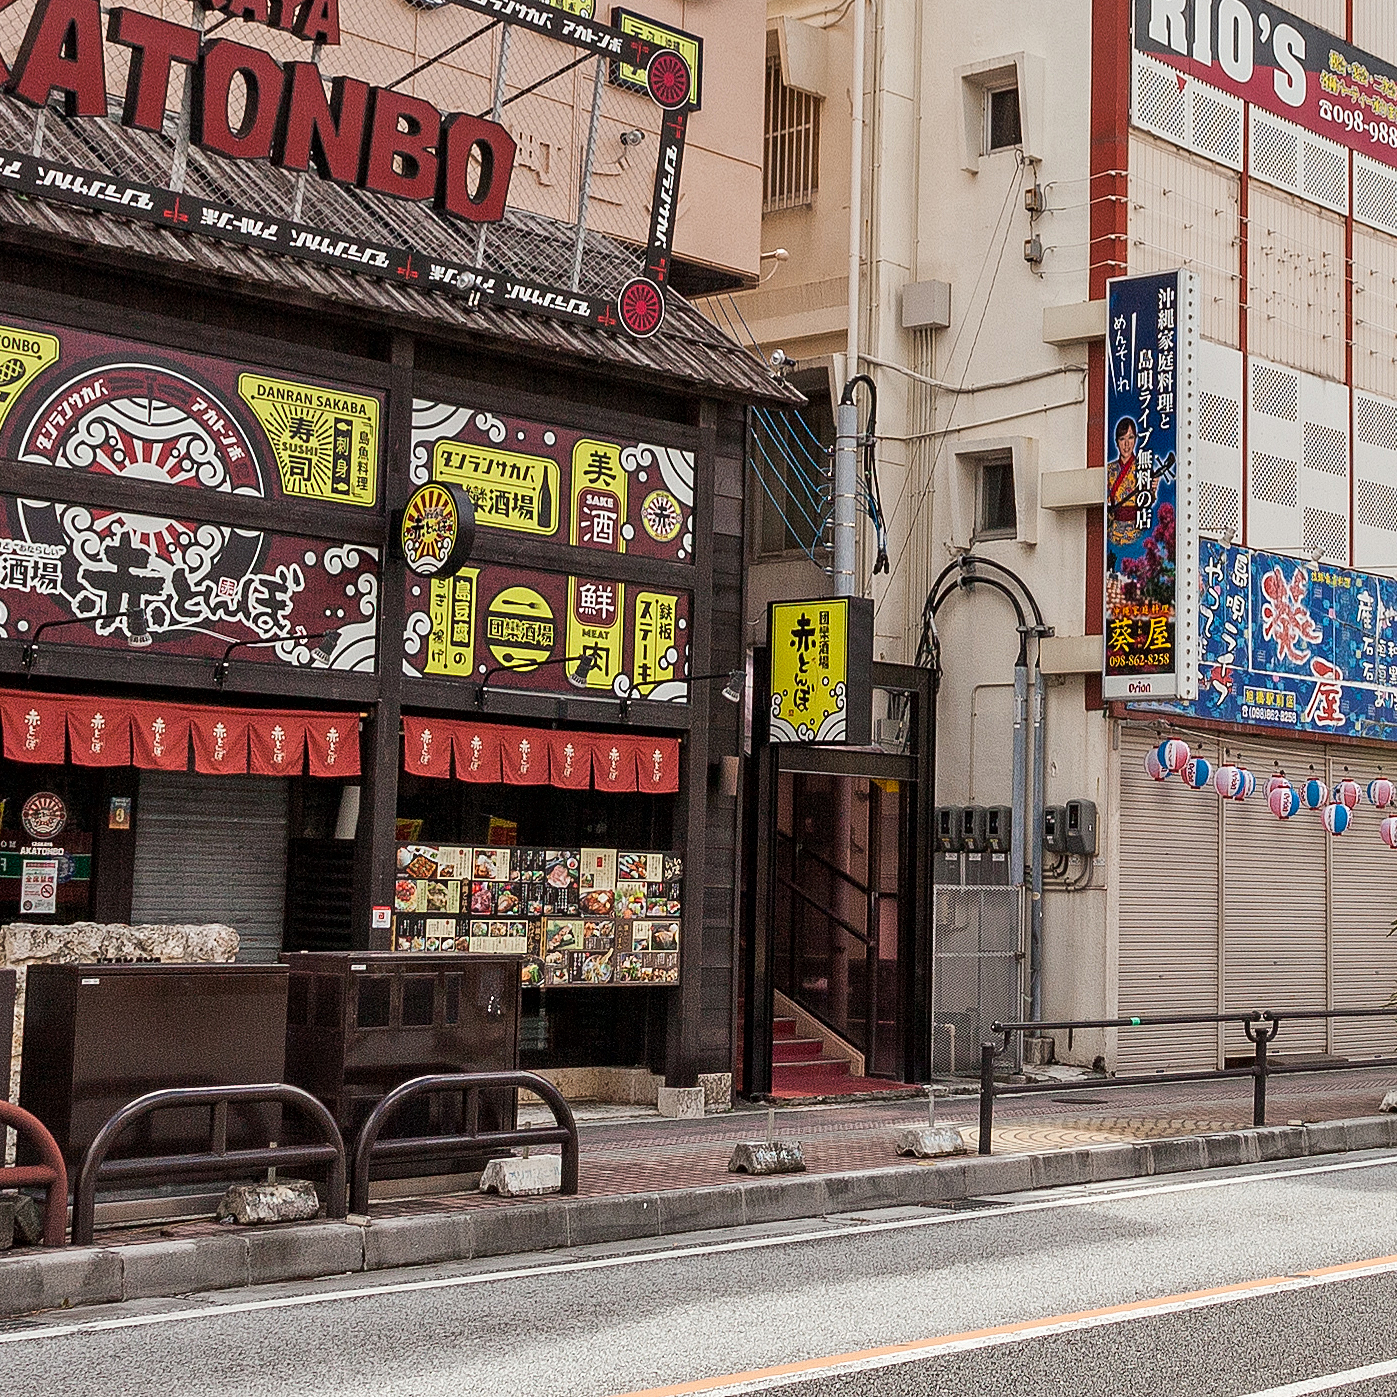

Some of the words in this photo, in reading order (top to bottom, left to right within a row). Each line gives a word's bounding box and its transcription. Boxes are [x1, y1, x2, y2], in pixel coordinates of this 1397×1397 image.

[562, 19, 622, 53] アカトンボ
[654, 144, 678, 249] ダンランサカバ
[1113, 315, 1130, 392] めんそーれ
[1156, 287, 1175, 430] 沖縄家庭料理と
[36, 377, 110, 452] ダンランサカバ
[257, 383, 314, 407] DANRAN
[316, 394, 368, 416] SAKABA
[190, 395, 248, 463] アカトンボ
[1135, 349, 1153, 530] 島唄ライブ無料の店
[281, 441, 319, 456] SUSHI
[335, 432, 349, 479] 刺身
[440, 451, 537, 483] ダンランサカバ
[583, 451, 617, 487] 美
[585, 494, 614, 508] SAKE
[581, 507, 618, 544] 酒
[579, 583, 615, 620] 鮮
[582, 628, 610, 641] MEAT
[658, 603, 672, 641] 鉄板
[638, 600, 653, 682] ステーキ
[790, 612, 817, 713] 赤とんぼ
[1109, 652, 1170, 668] 098-862-8258
